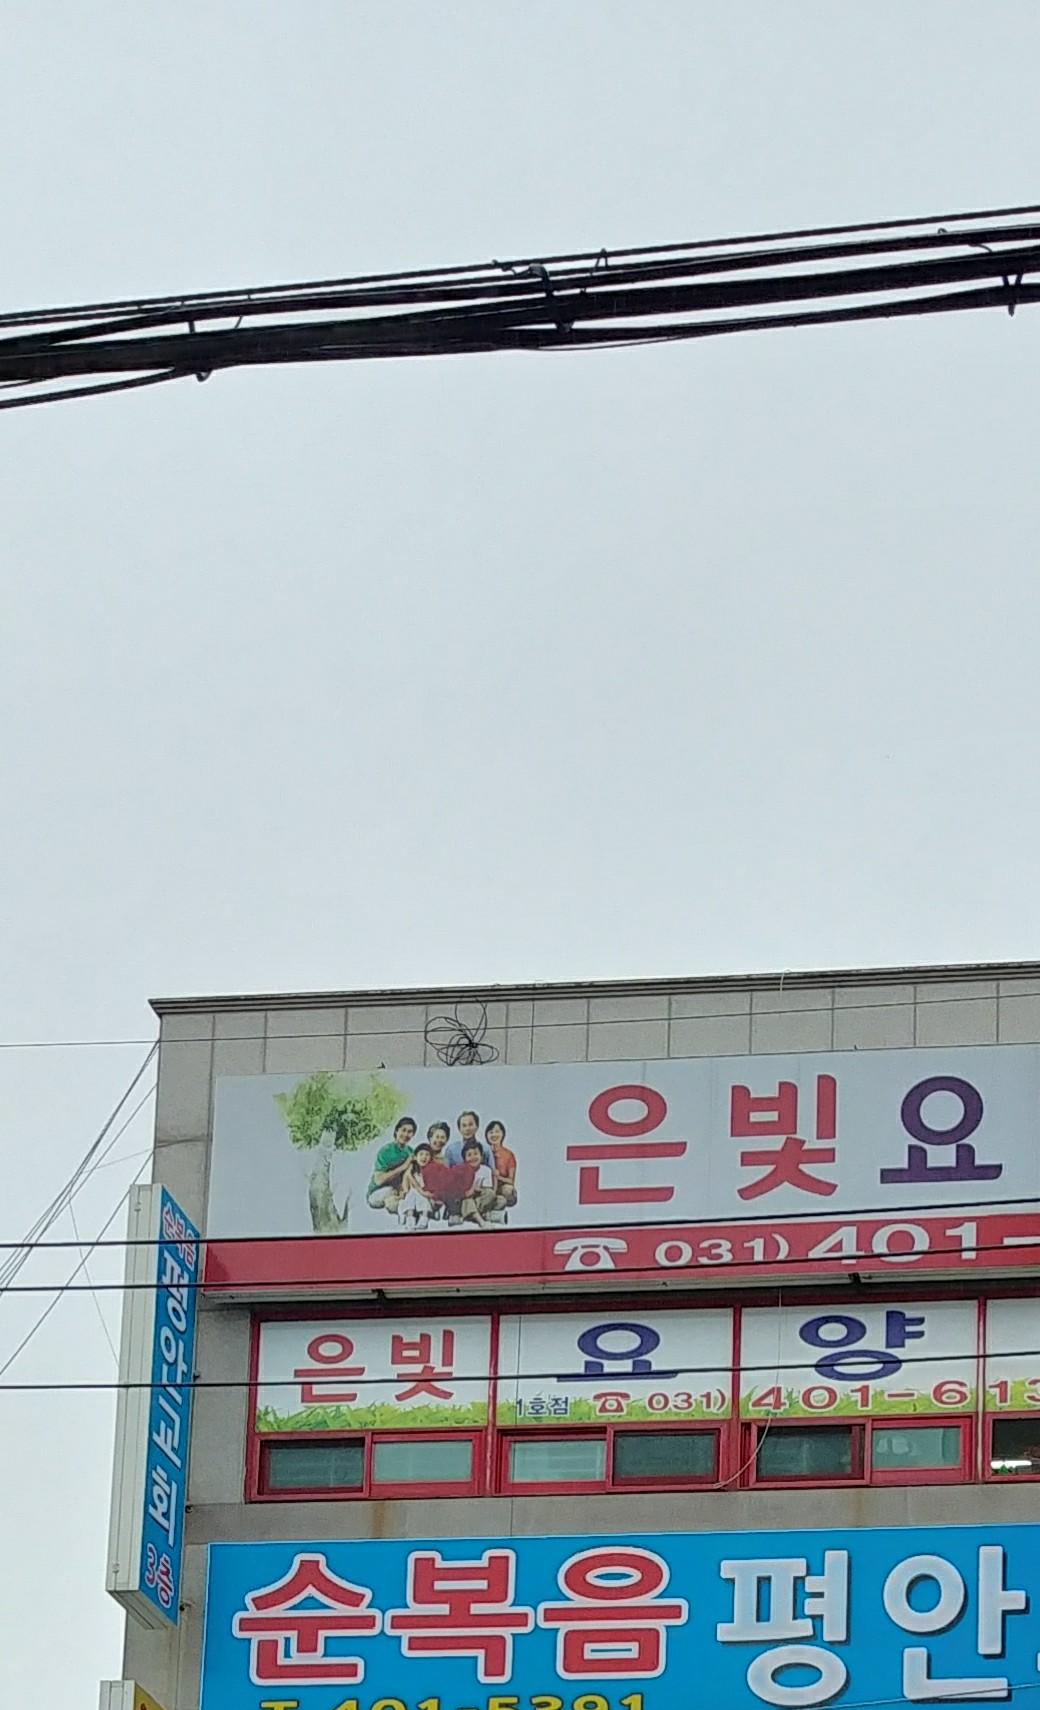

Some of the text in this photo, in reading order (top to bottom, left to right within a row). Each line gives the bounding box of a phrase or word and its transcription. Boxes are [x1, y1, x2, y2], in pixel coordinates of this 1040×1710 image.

[163, 1201, 198, 1271] 순복음
[654, 1233, 789, 1268] 031)
[149, 1248, 189, 1547] 평안교회
[515, 1394, 570, 1419] 1호점
[647, 1387, 727, 1416] 031)
